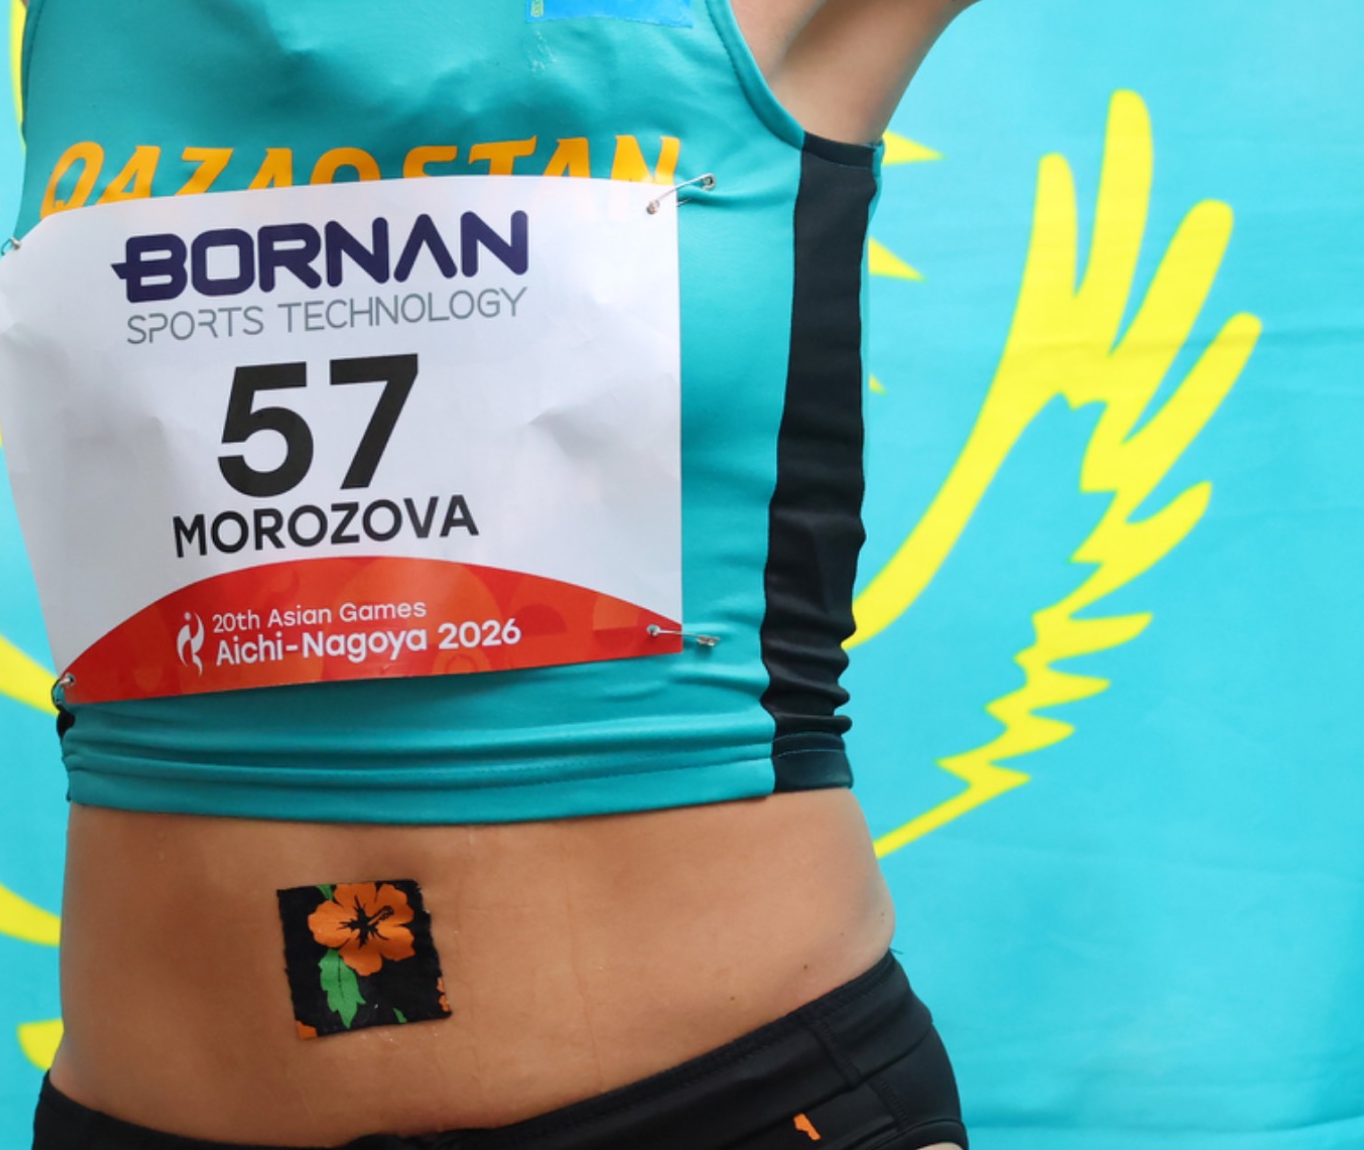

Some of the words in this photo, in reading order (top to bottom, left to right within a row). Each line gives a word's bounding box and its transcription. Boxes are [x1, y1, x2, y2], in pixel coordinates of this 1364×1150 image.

[110, 210, 529, 304] BORNAN
[126, 305, 265, 345] SPORTS
[277, 286, 528, 333] TECHNOLOGY
[218, 353, 419, 498] 57
[173, 495, 479, 558] MOROZOVA
[212, 609, 261, 634] 20th
[267, 605, 332, 628] Asian
[339, 601, 427, 623] Games
[215, 628, 428, 667] Aichi-Nagoya
[437, 617, 522, 650] 2026
